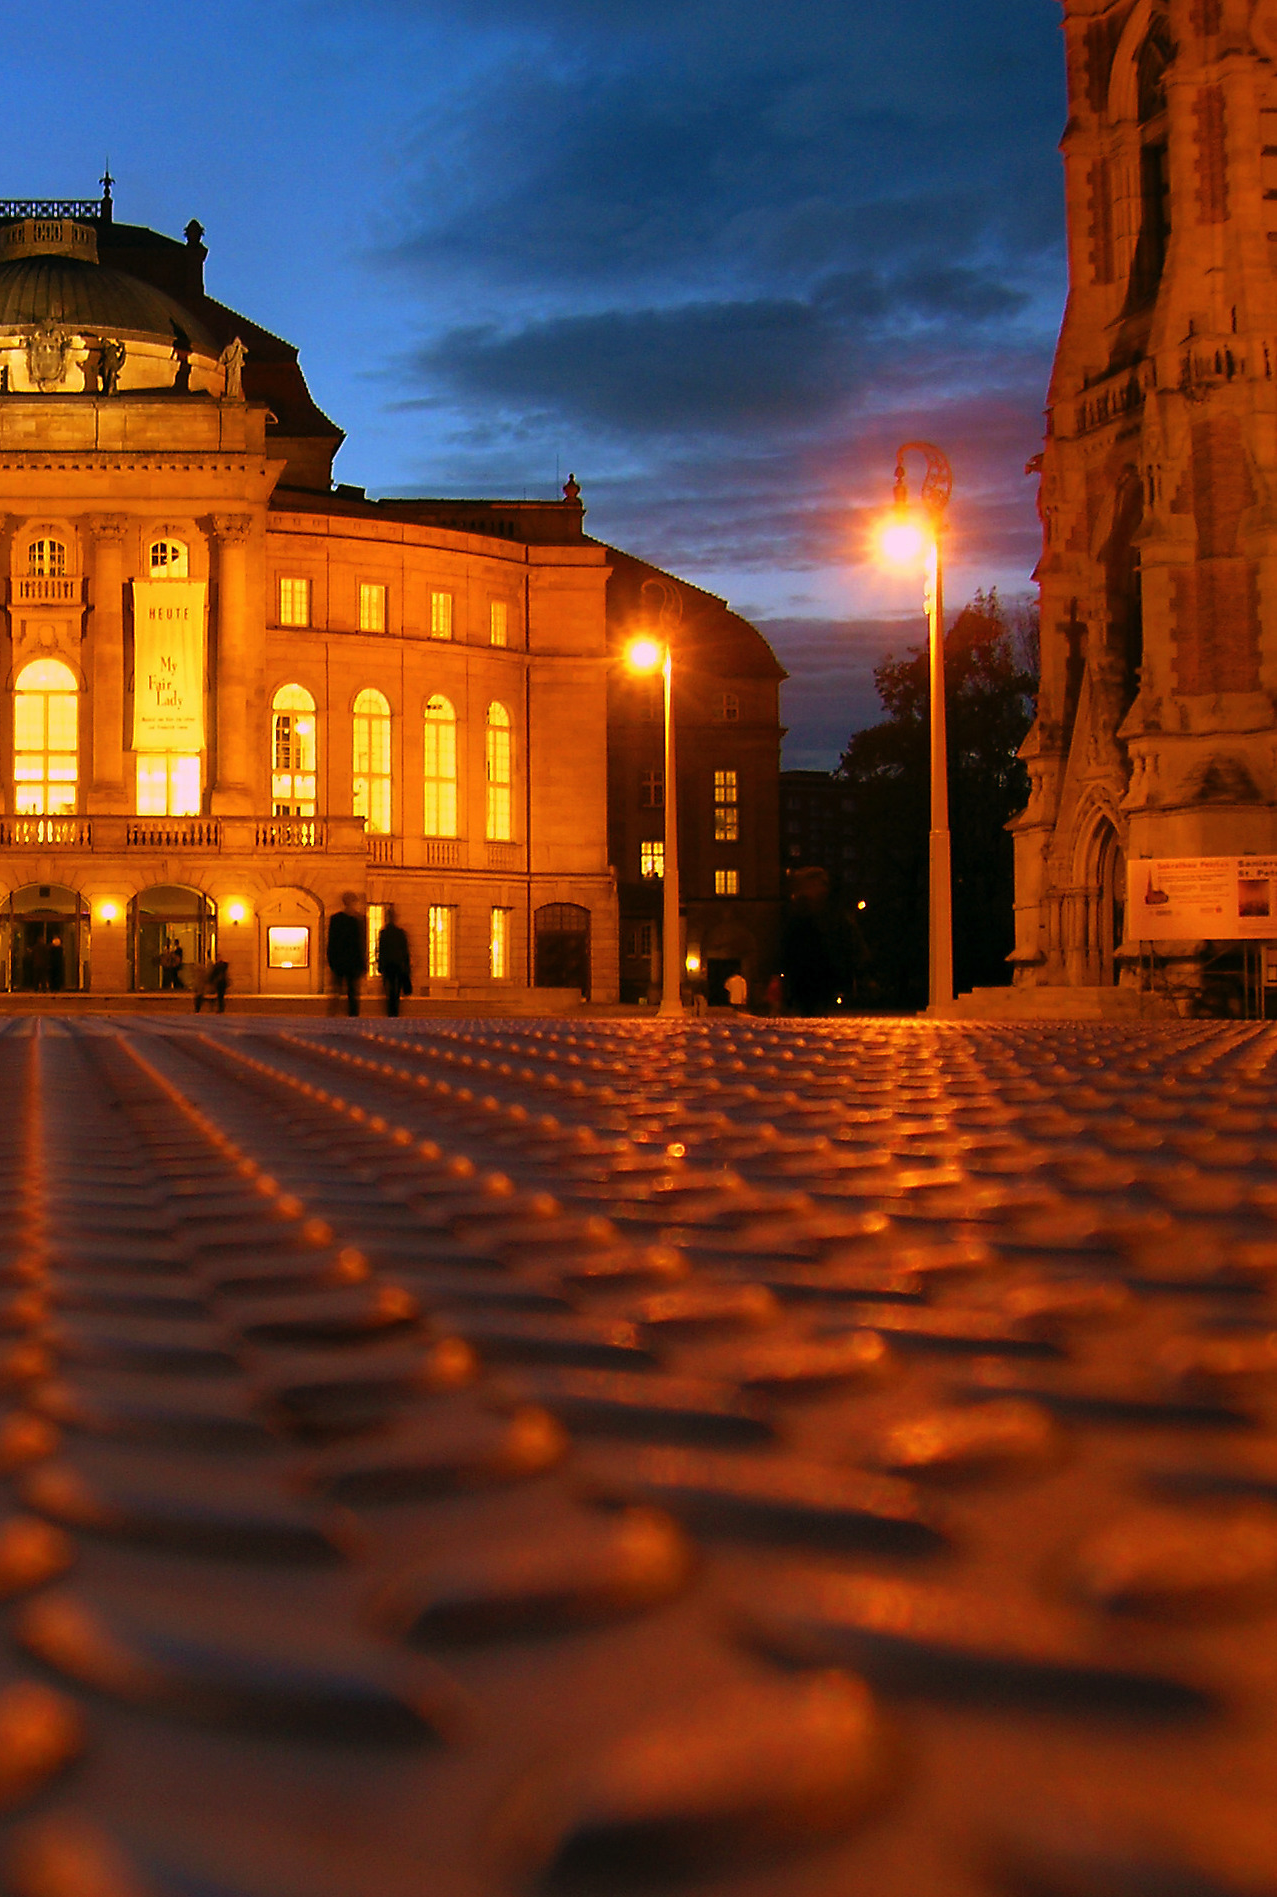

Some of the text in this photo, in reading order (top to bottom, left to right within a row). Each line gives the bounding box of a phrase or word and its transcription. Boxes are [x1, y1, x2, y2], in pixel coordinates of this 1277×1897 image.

[149, 607, 189, 620] HEUTE
[160, 656, 177, 676] My
[148, 675, 172, 690] Fair
[156, 690, 183, 710] Lady
